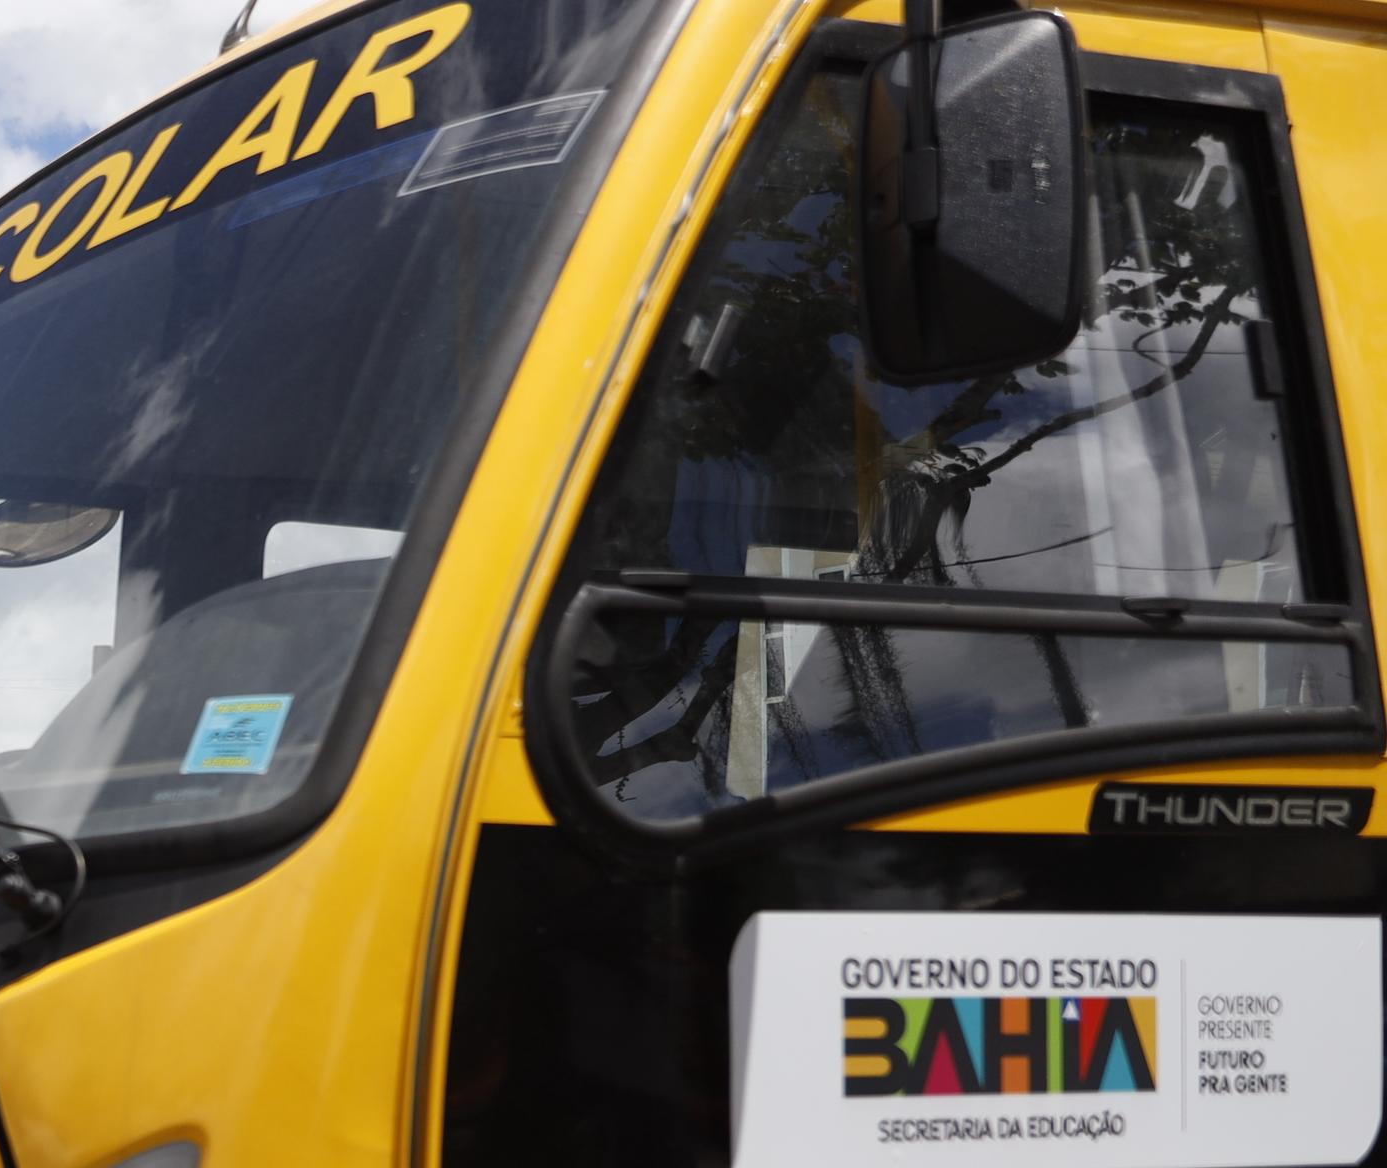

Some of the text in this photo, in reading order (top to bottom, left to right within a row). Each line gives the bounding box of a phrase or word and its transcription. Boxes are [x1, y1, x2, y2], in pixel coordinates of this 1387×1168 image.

[1103, 791, 1351, 828] THUNDER
[842, 958, 1157, 989] GOVERNO DO ESTADO
[1197, 995, 1282, 1015] GOVERNO
[1198, 1020, 1271, 1039] PRESENTE
[844, 997, 1156, 1097] BAHIA
[1198, 1049, 1265, 1069] FUTURO
[1198, 1074, 1287, 1094] PRA GENTE
[877, 1109, 1124, 1143] SECRETARIA DA EDUCAÇÃO
